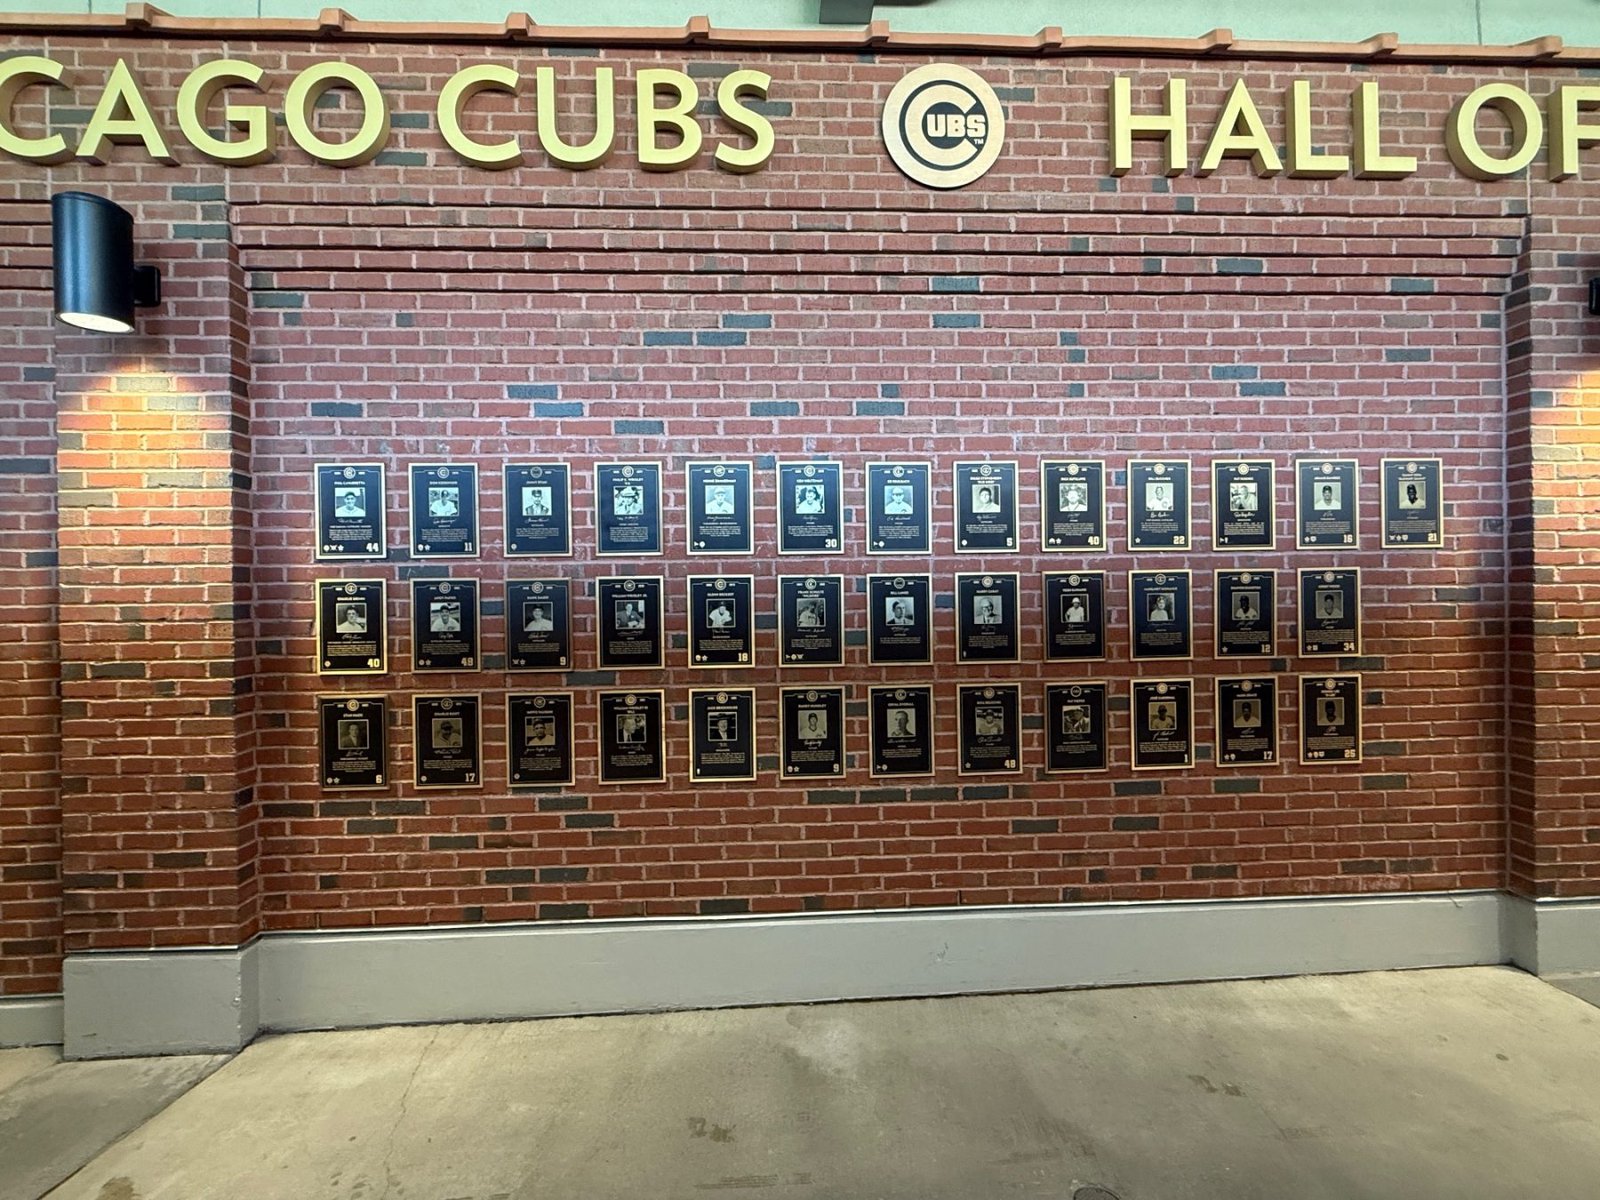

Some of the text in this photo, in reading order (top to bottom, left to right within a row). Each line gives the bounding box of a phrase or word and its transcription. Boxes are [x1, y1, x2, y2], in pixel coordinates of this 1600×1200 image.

[437, 66, 775, 172] CUBS
[1110, 77, 1600, 176] HALL OF
[1087, 536, 1100, 545] 40
[1173, 535, 1185, 544] 22
[1427, 533, 1437, 541] 21
[366, 542, 379, 552] 44
[464, 542, 473, 551] 11
[825, 539, 837, 548] 30
[1343, 642, 1355, 651] 34
[738, 652, 748, 662] 18
[367, 658, 380, 668] 40
[1263, 751, 1273, 760] 17
[1344, 749, 1356, 758] 25
[464, 773, 475, 782] 17
